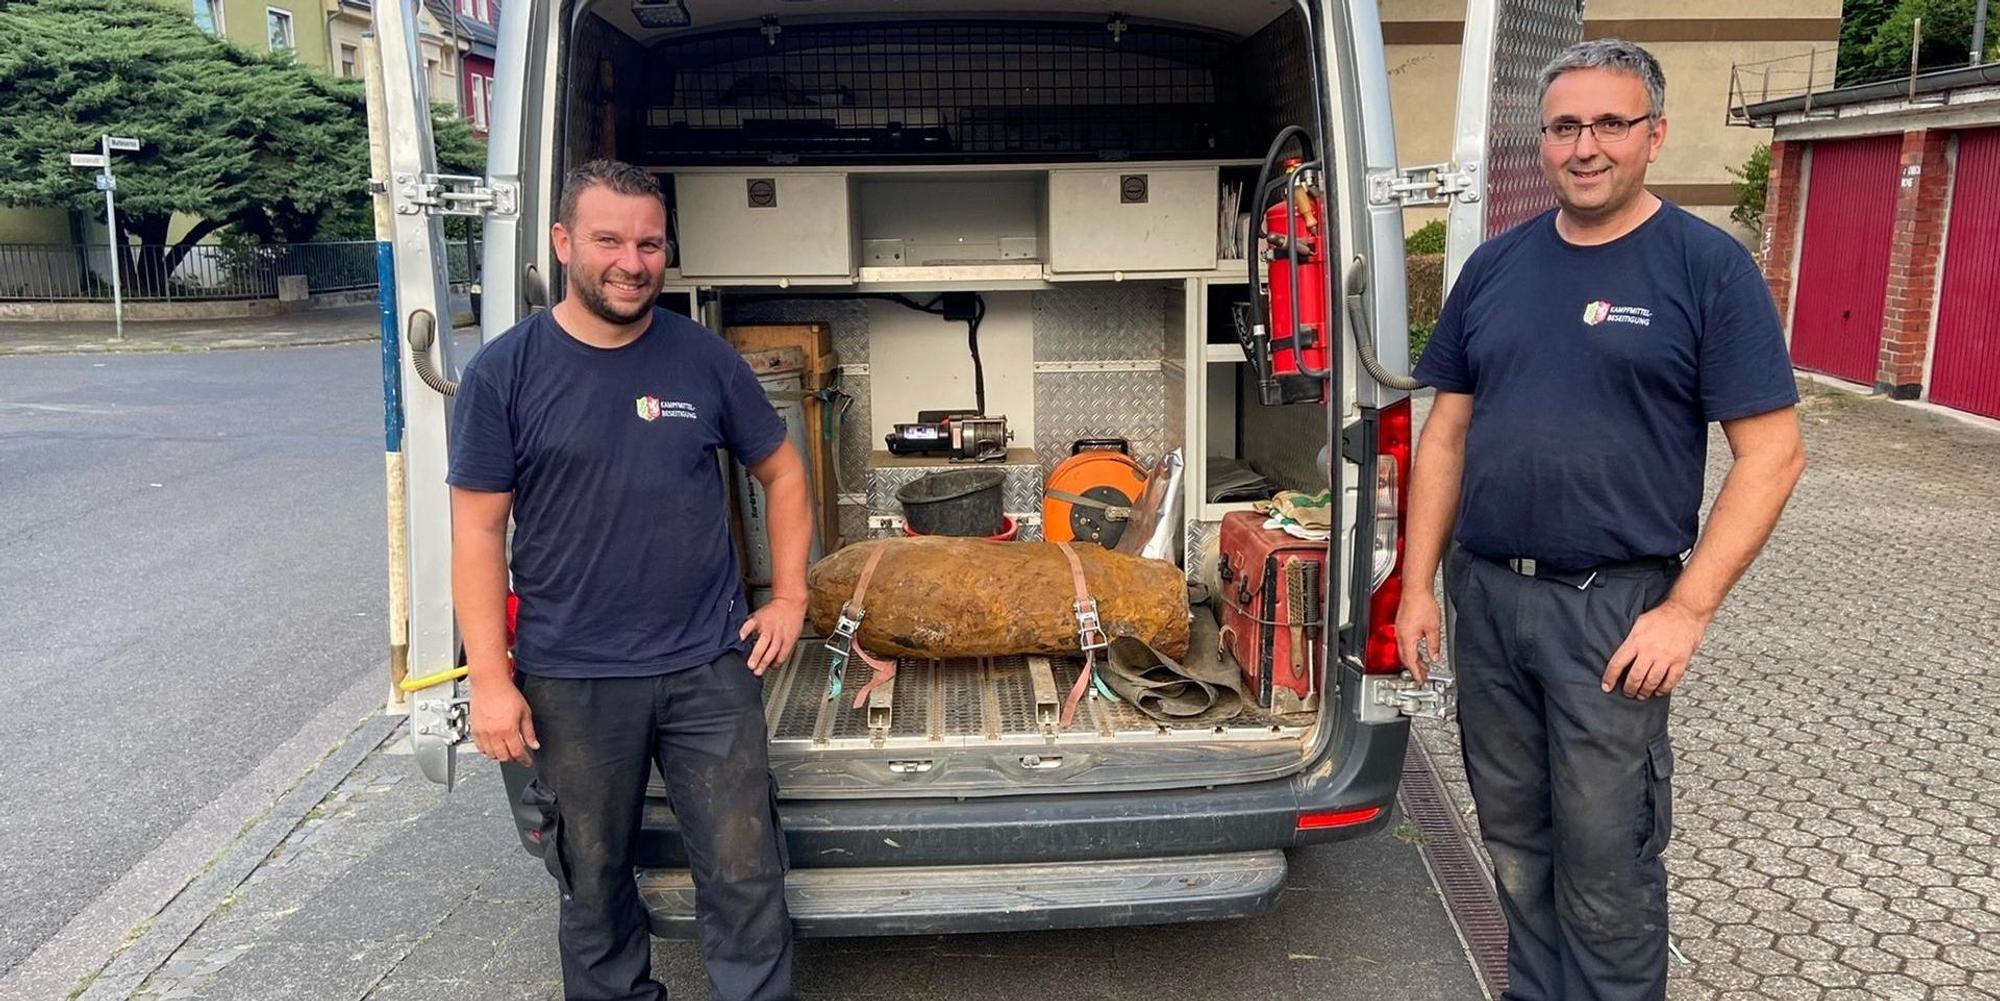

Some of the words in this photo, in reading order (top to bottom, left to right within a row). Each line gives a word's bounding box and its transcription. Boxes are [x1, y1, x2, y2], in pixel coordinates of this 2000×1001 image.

[1609, 305, 1652, 317] KAMPFMITTEL-
[1606, 314, 1650, 326] BESEITIGUNG
[660, 401, 696, 412] KAMPFMITTEL-
[661, 410, 697, 419] BESEITIGUNG
